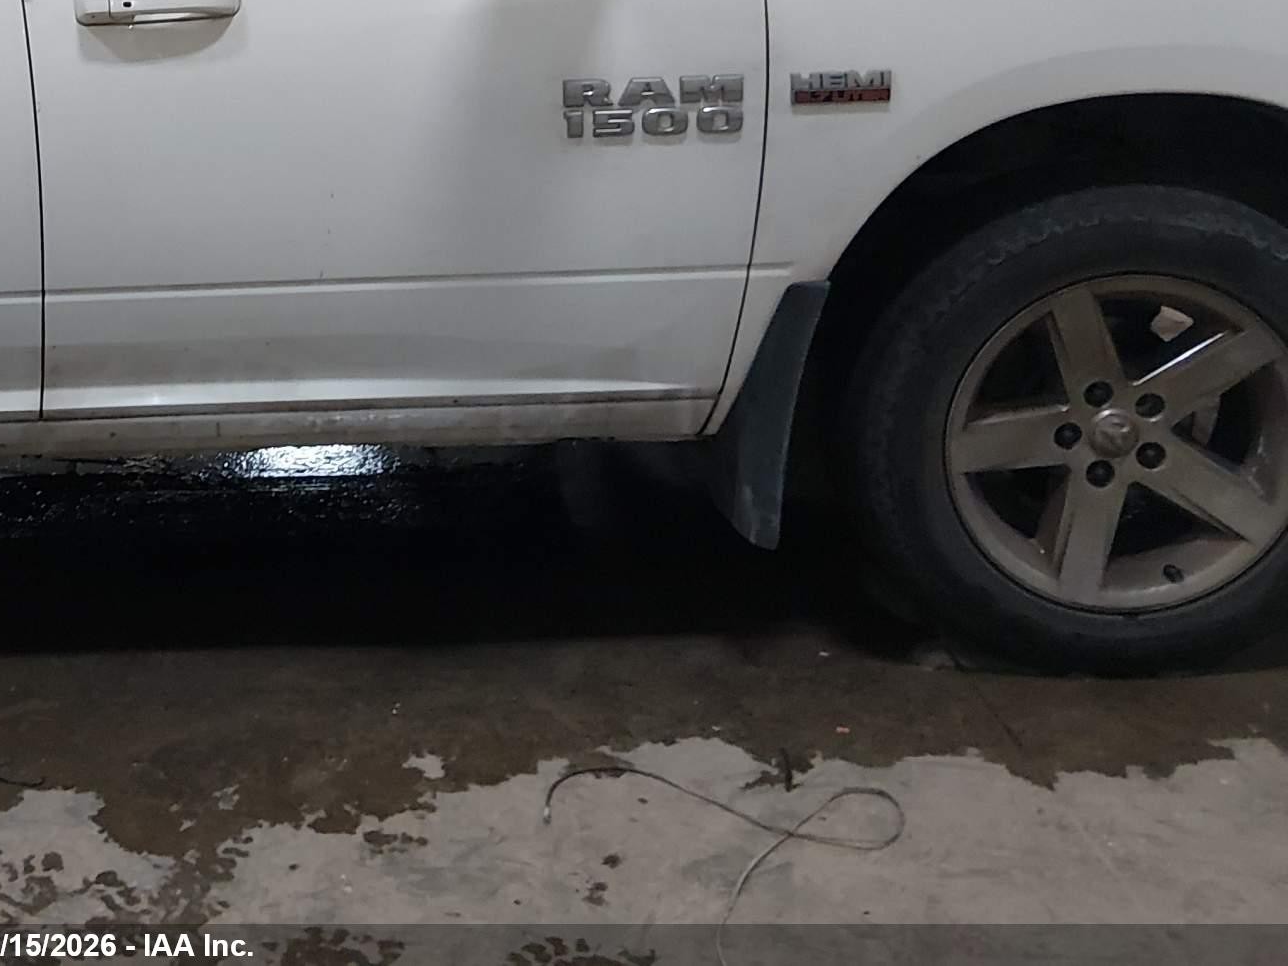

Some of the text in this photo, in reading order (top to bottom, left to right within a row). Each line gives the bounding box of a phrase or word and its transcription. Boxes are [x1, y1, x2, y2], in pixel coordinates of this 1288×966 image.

[563, 74, 745, 108] RAM
[790, 70, 891, 90] HEMI
[563, 107, 744, 138] 1500
